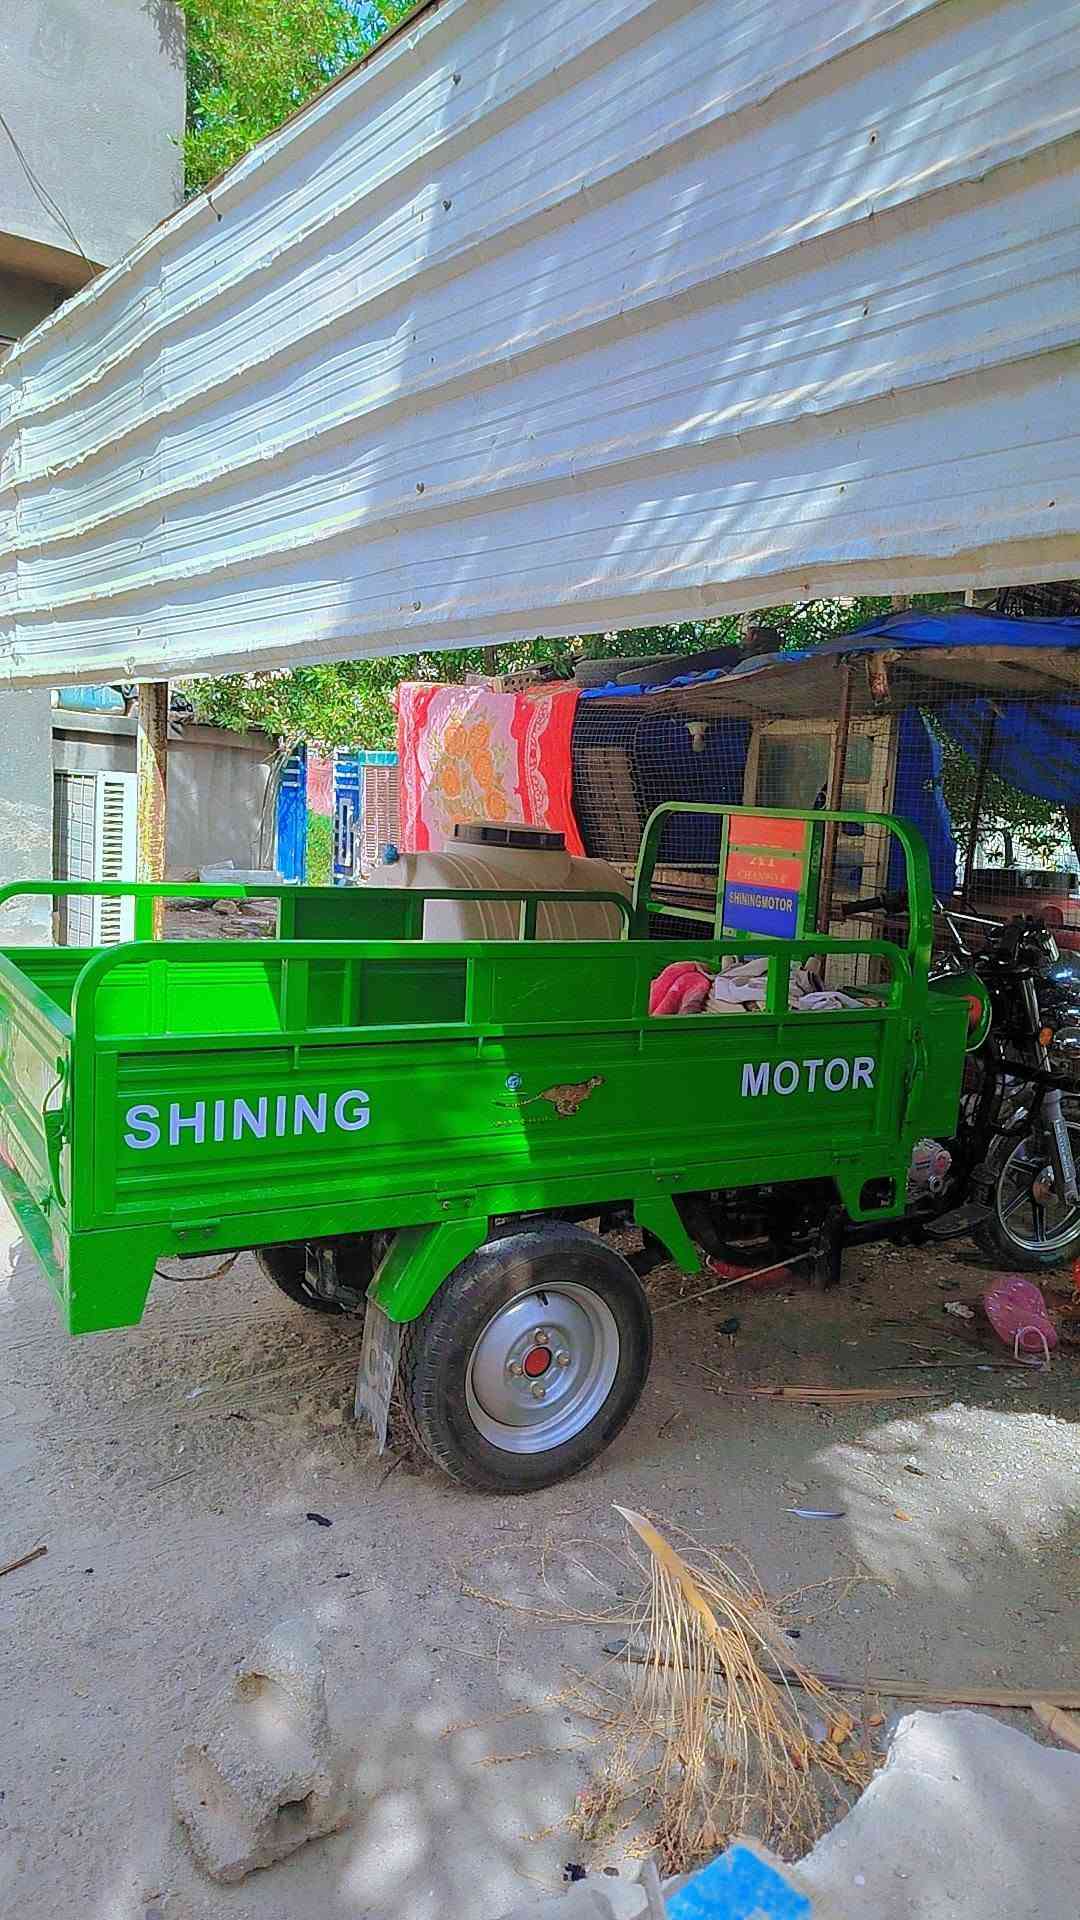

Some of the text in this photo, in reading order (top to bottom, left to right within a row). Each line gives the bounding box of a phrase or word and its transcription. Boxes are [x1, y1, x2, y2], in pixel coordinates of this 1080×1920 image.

[728, 891, 793, 913] SHININGMOTOR
[124, 1057, 875, 1149] SHINING MOTOR
